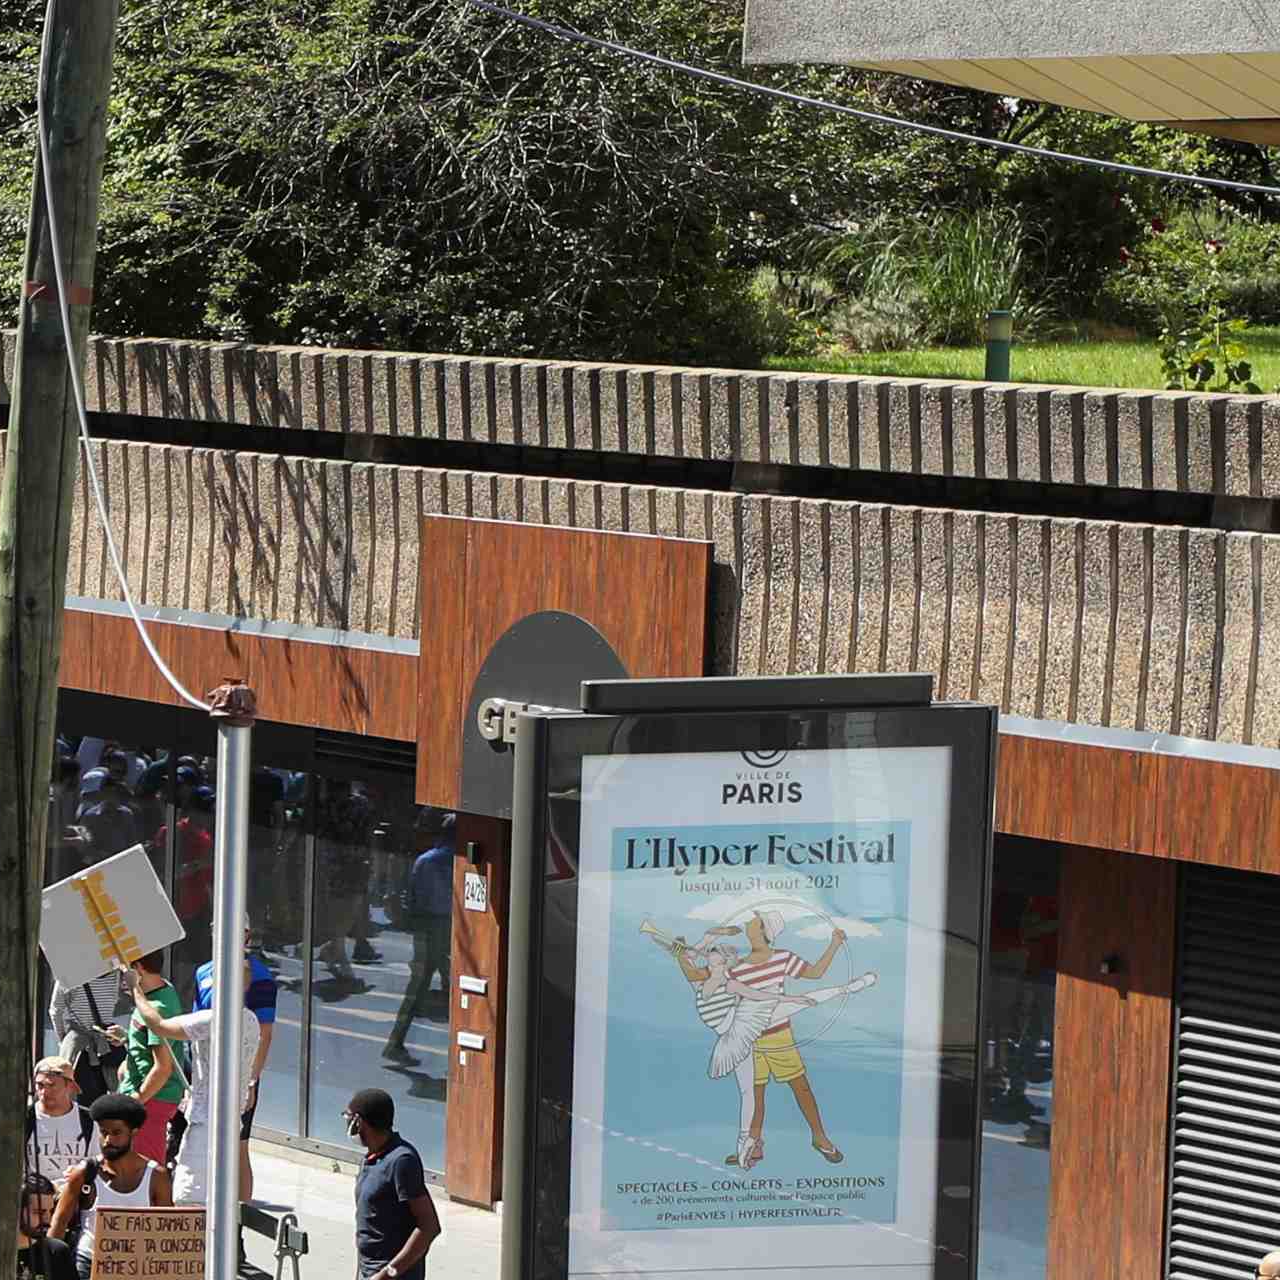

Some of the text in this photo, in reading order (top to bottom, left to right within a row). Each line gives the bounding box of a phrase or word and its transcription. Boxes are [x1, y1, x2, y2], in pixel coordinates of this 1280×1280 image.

[775, 772, 791, 780] DE
[722, 782, 803, 804] PARIS
[624, 832, 895, 876] L'Hyper Festival
[744, 875, 761, 890] 31
[805, 874, 841, 890] 2021
[616, 1175, 887, 1194] SPECTACLES CONCERTS EXPOSITIONS
[655, 1193, 674, 1205] 200
[836, 1188, 865, 1202] public
[126, 1214, 152, 1232] FAIS
[155, 1216, 190, 1232] JAMAIS
[656, 1207, 842, 1223] #ParisENVIES HYPERFESTIVAL.FR
[144, 1239, 157, 1253] TA
[160, 1235, 206, 1253] CONSCIEN
[96, 1255, 126, 1273] MÊME
